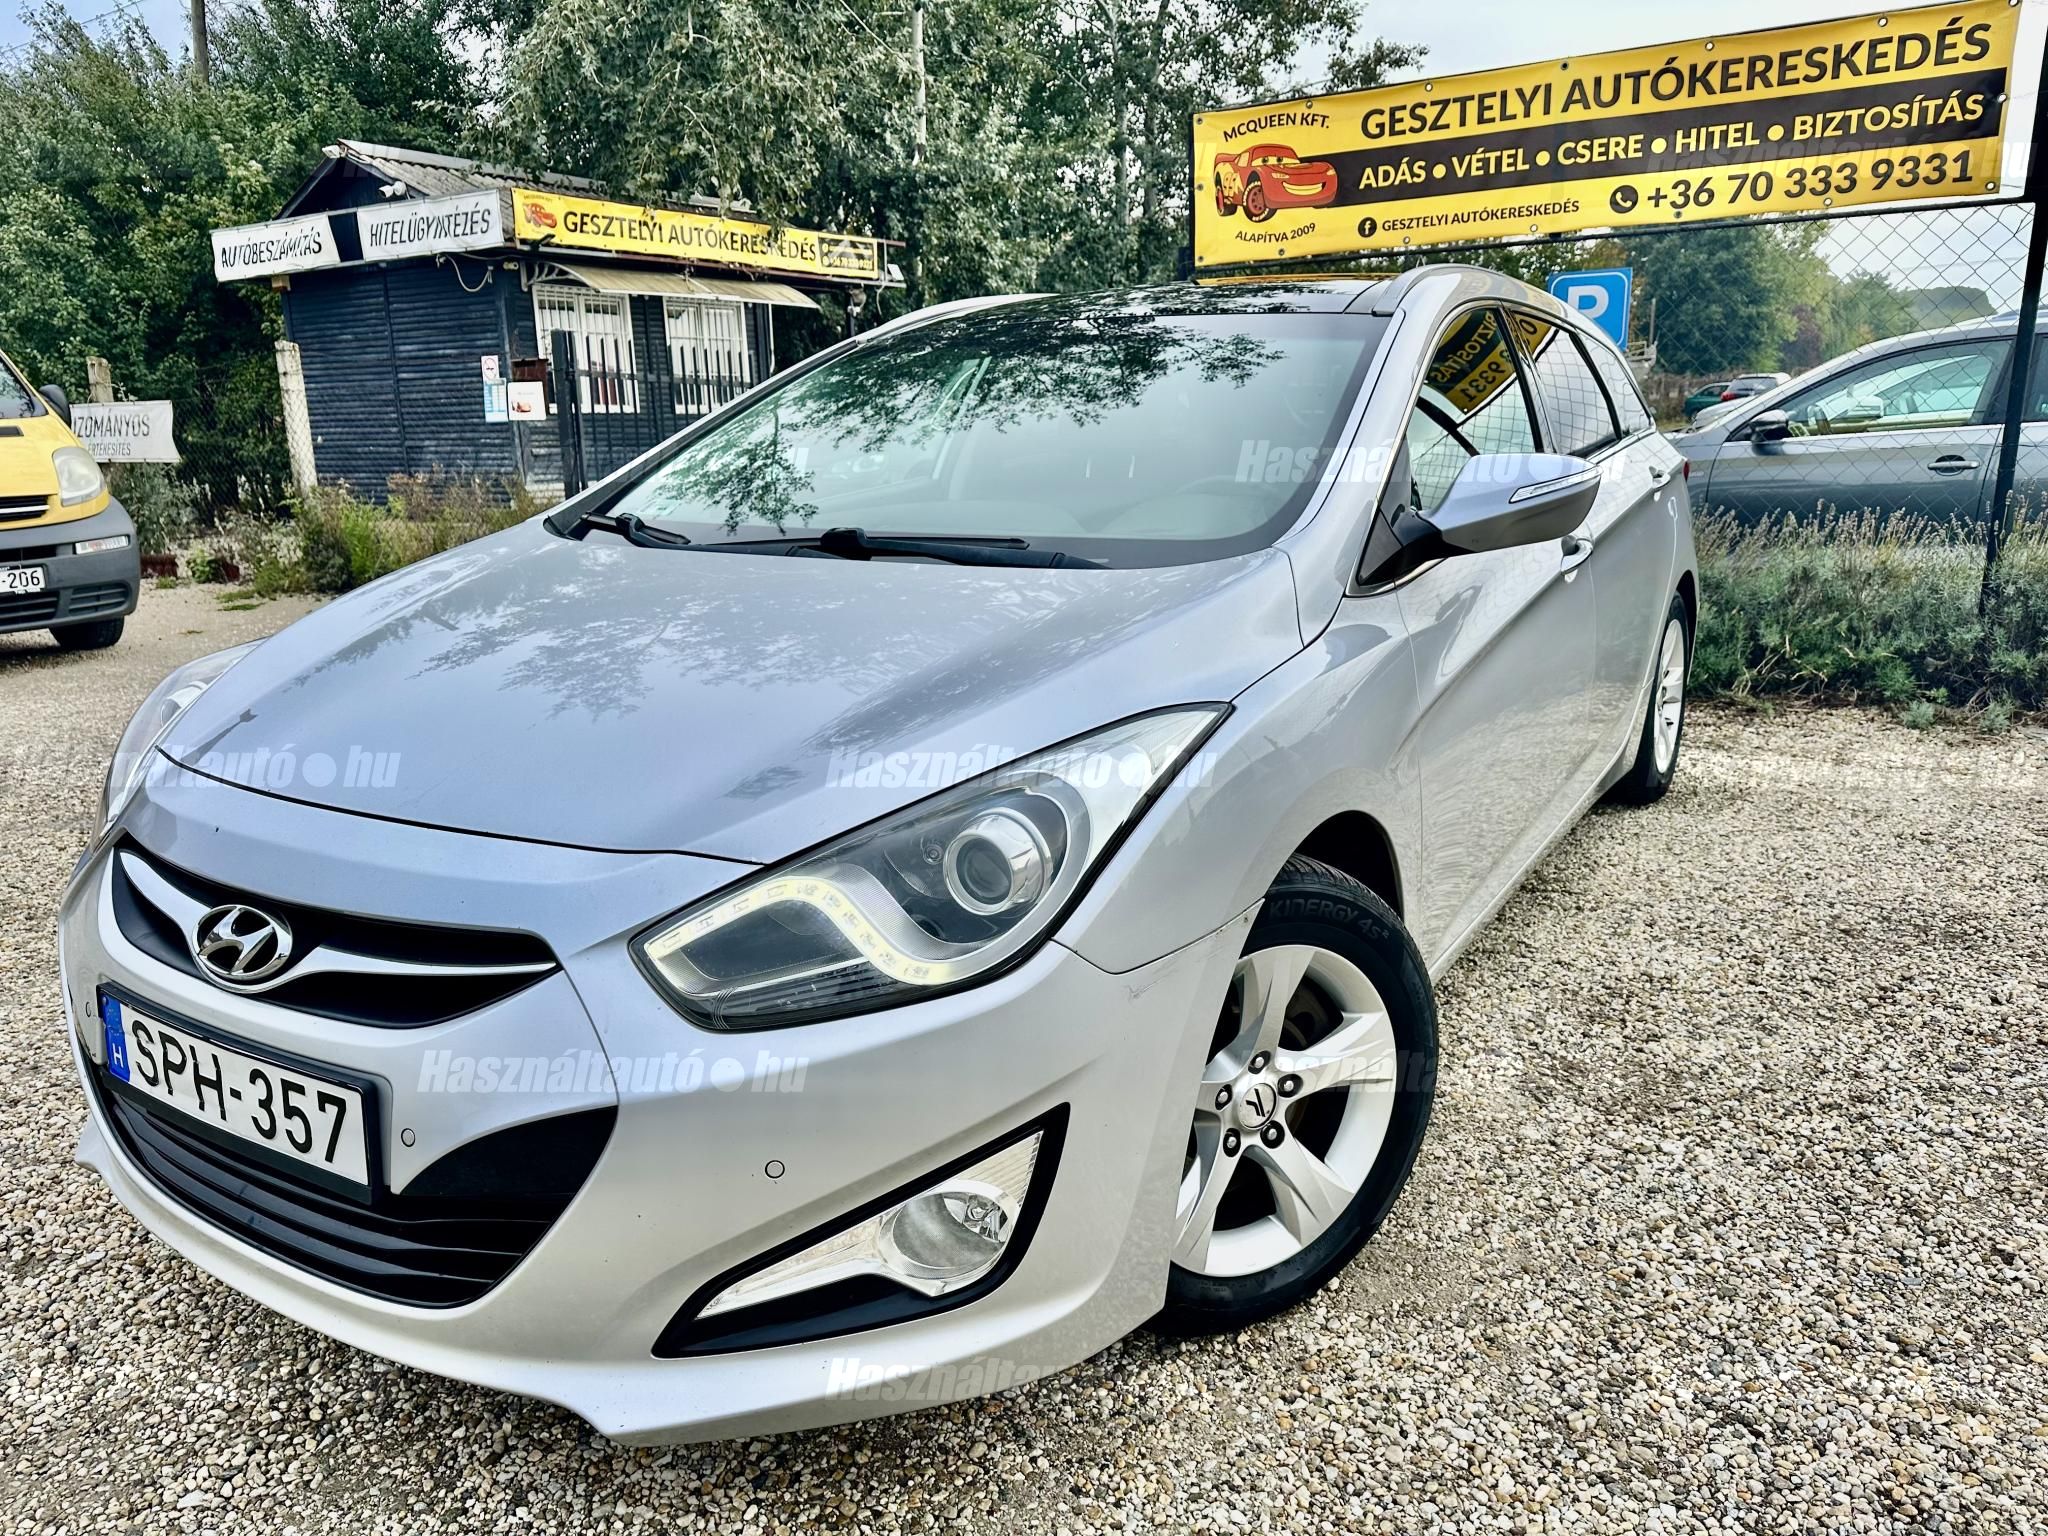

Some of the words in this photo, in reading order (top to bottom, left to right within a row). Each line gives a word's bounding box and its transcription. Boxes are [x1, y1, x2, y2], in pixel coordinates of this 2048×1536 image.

[1361, 83, 1552, 140] GESZTELYI
[1561, 16, 1992, 114] AUTÓKERESKEDÉS
[1223, 113, 1296, 142] MCQUEEN
[1300, 112, 1330, 129] KFT.
[1358, 157, 1427, 190] ADÁS
[1451, 143, 1530, 178] VÉTEL
[1557, 134, 1644, 166] CSERE
[1674, 122, 1760, 154] HITEL
[1793, 89, 1984, 141] BIZTOSÍTÁS
[1647, 177, 1716, 210] +36
[1727, 171, 1774, 204] 70
[1784, 162, 1858, 198] 333
[1870, 149, 1974, 191] 9331
[564, 211, 663, 243] GESZTELYI
[1381, 213, 1449, 232] GESZTELYI
[1451, 200, 1580, 225] AUTÓKERESKEDÉS
[1235, 230, 1289, 243] ALAPÍTVA
[1290, 222, 1316, 240] 2009
[1567, 285, 1609, 319] P
[1269, 899, 1358, 922] KINERGY
[112, 1043, 124, 1068] H
[131, 1019, 347, 1164] SPH-357
